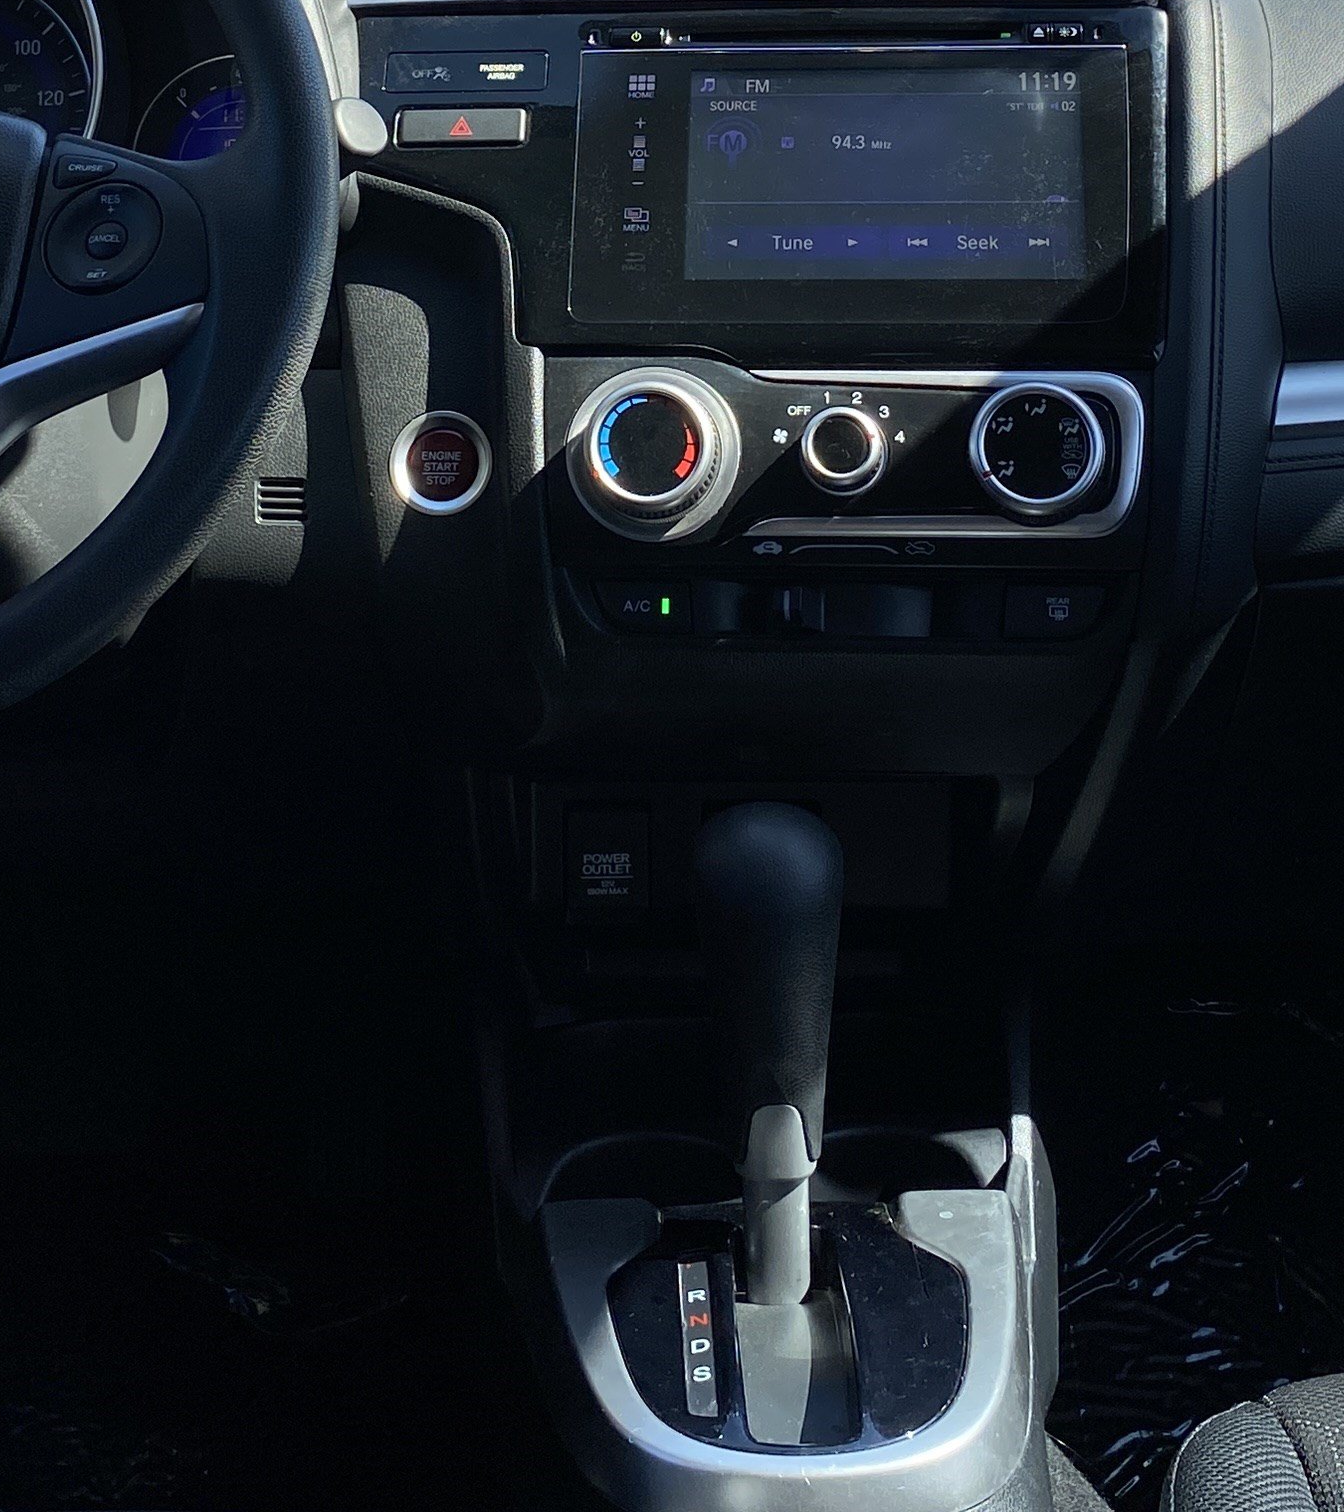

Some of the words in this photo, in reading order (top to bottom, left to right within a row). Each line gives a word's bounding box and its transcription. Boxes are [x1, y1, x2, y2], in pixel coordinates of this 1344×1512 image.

[14, 39, 41, 56] 100
[479, 63, 524, 72] PASSENGER
[412, 68, 434, 79] OFF
[487, 72, 516, 80] AIRBAG
[745, 79, 770, 94] FM
[1018, 71, 1077, 91] 11:19
[37, 90, 64, 106] 120
[628, 90, 654, 98] HOME
[709, 100, 758, 112] SOURCE
[1061, 100, 1076, 112] 02
[831, 134, 865, 151] 94.3
[870, 140, 892, 150] MHz
[628, 149, 650, 158] VOL
[67, 163, 105, 173] CRUISE
[100, 194, 121, 205] RES
[623, 224, 650, 233] MENU
[88, 234, 122, 244] CANCEL
[771, 234, 814, 251] Tune
[957, 234, 1000, 251] Seek
[85, 271, 109, 279] SET
[824, 392, 830, 404] 1
[851, 392, 862, 404] 2
[787, 405, 812, 416] OFF
[878, 406, 890, 418] 3
[894, 431, 906, 442] 4
[421, 451, 462, 462] ENGINE
[423, 462, 459, 472] START
[425, 475, 455, 486] STOP
[623, 600, 651, 612] A/C
[1046, 597, 1070, 606] REAR
[583, 853, 630, 864] POWER
[582, 864, 631, 874] OUTLET
[609, 887, 628, 895] MAX
[687, 1289, 707, 1303] R
[689, 1312, 709, 1327] N
[690, 1338, 711, 1354] D
[692, 1365, 712, 1382] S
